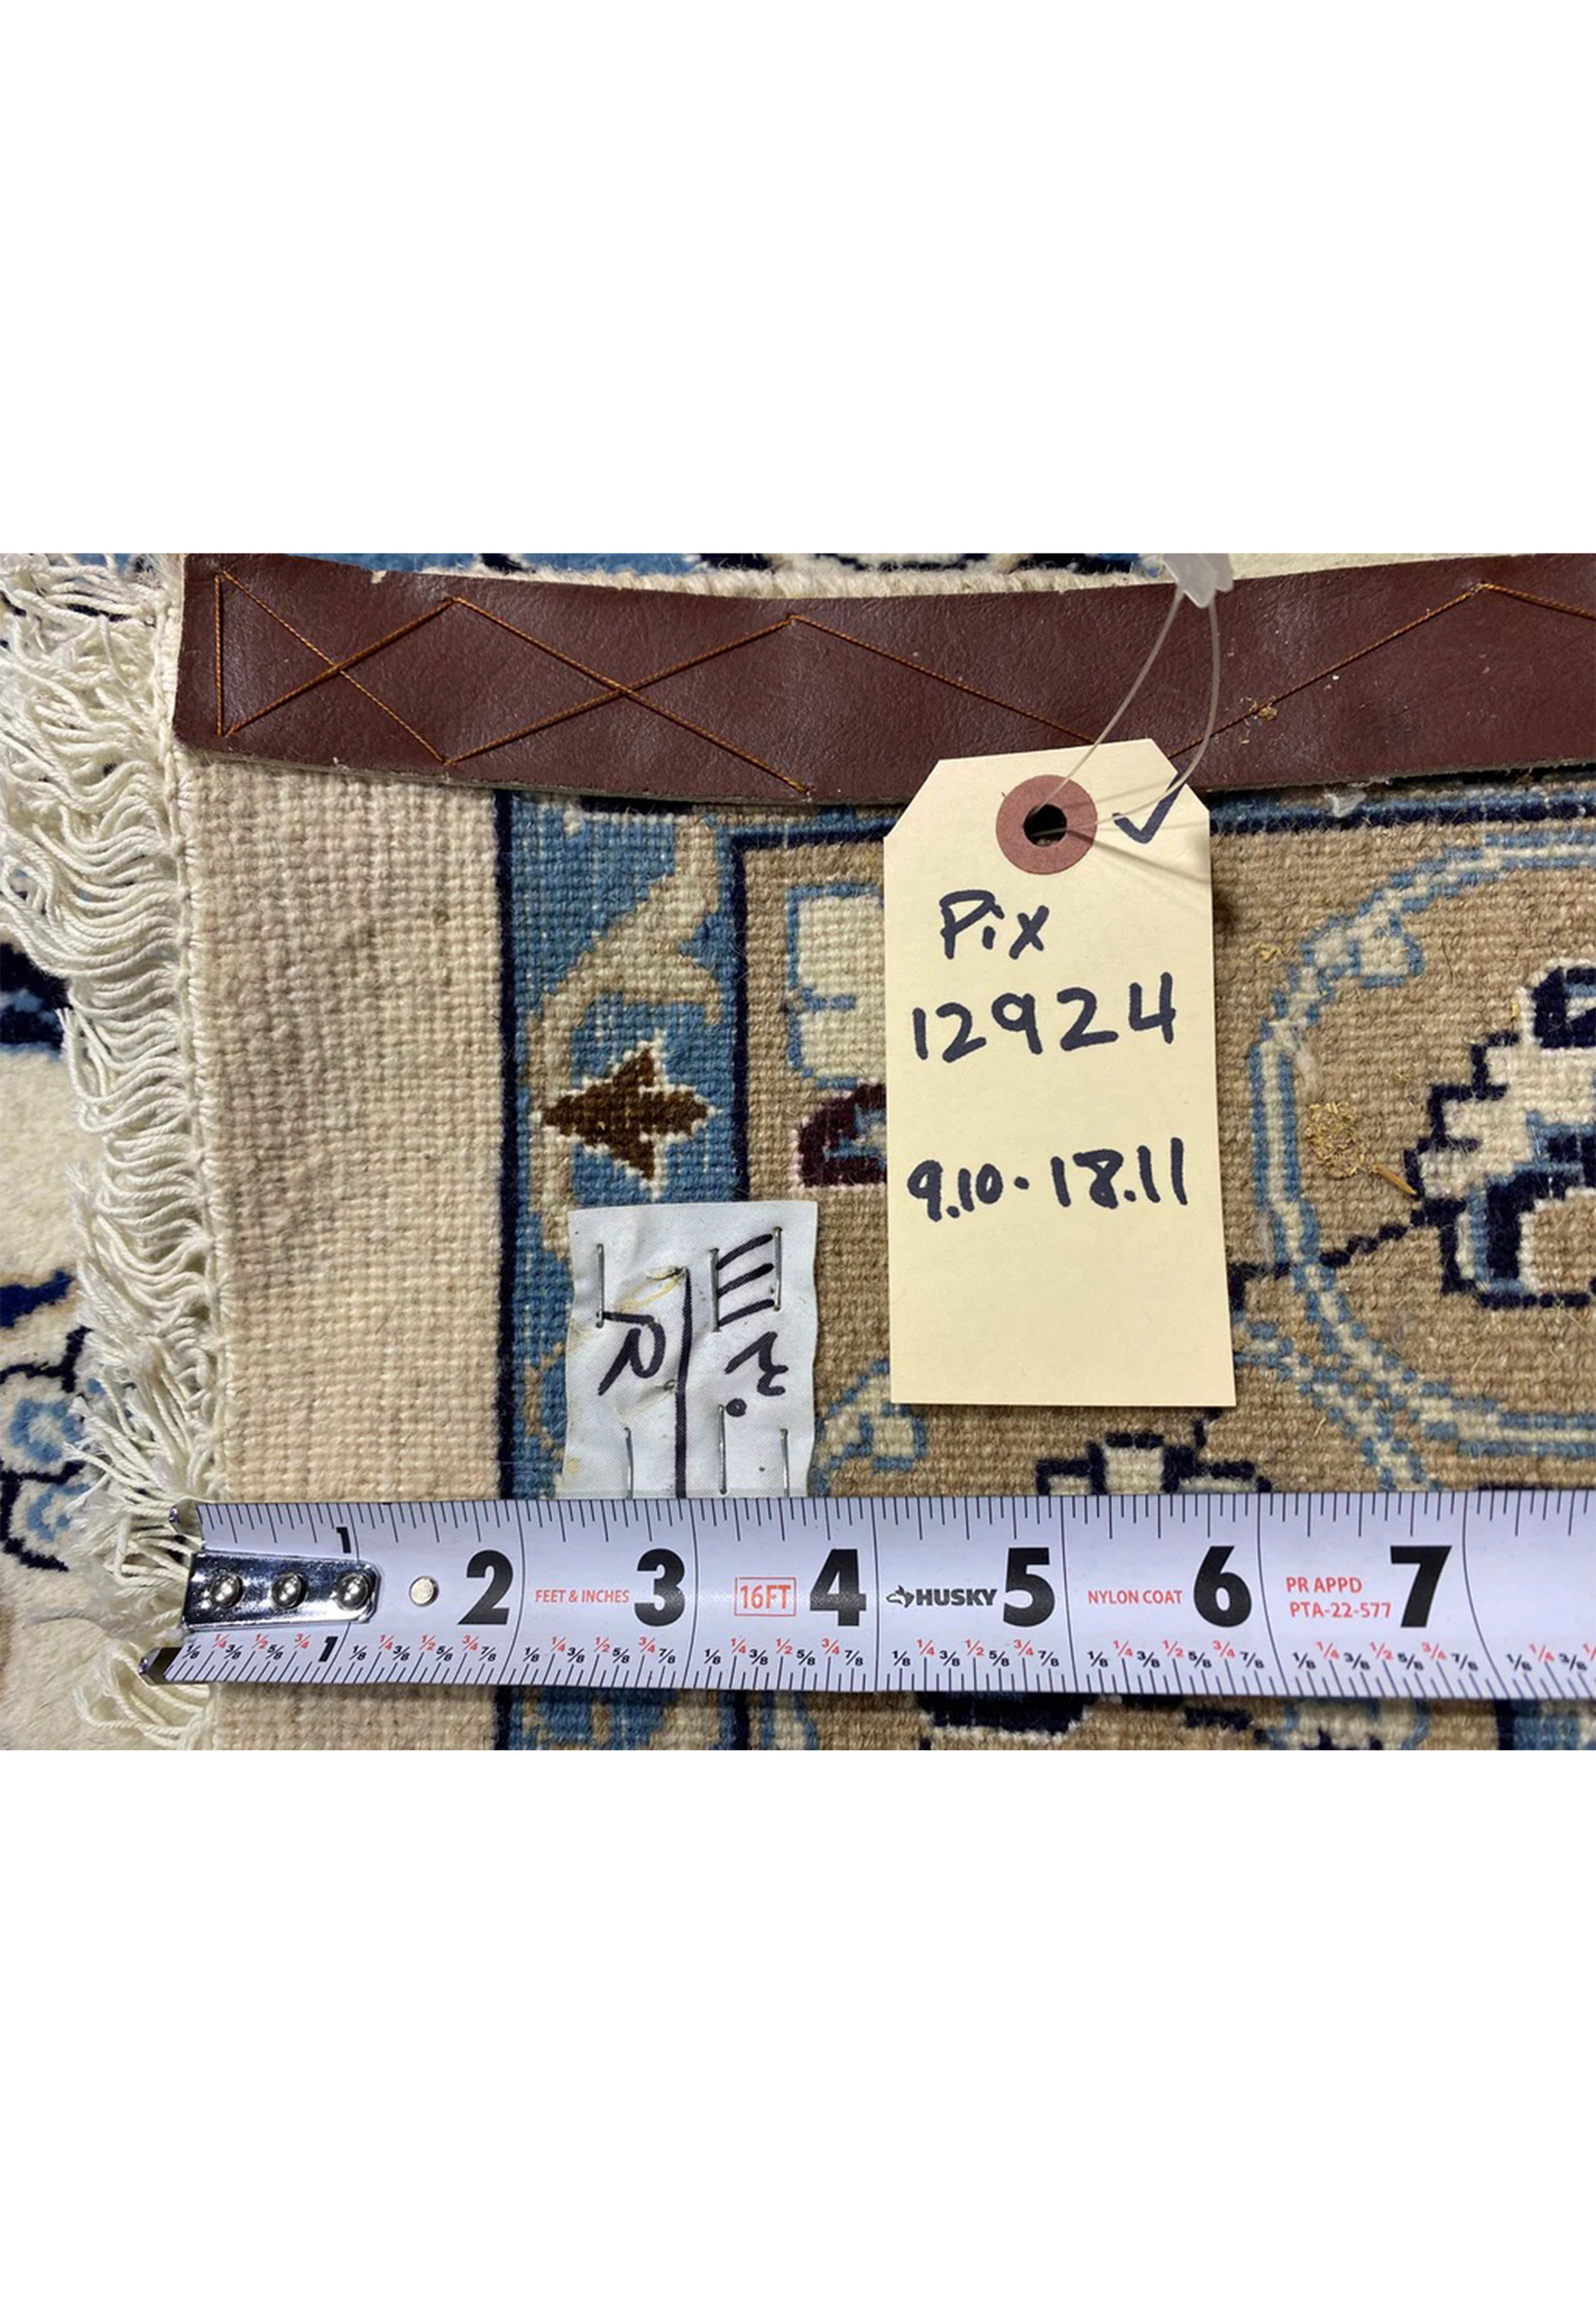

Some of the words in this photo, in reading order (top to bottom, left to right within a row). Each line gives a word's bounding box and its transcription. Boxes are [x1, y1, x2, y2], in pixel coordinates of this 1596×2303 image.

[939, 889, 1049, 960] Pix
[912, 971, 1176, 1063] 12924
[337, 1526, 352, 1554] 1
[457, 1549, 513, 1625] 2
[535, 1589, 566, 1603] FEET
[568, 1589, 579, 1603] &
[581, 1589, 630, 1604] INCHES
[634, 1548, 685, 1627] 3
[739, 1584, 791, 1609] 16FT
[809, 1549, 867, 1627] 4
[916, 1588, 998, 1607] HUSKY
[1003, 1547, 1056, 1627] 5
[1088, 1590, 1139, 1605] NYLON
[1143, 1590, 1182, 1605] COAT
[1193, 1545, 1252, 1628] 6
[1286, 1576, 1309, 1592] PR
[1313, 1576, 1362, 1594] APPD
[1390, 1545, 1453, 1628] 7
[1290, 1602, 1392, 1619] PTA-22-577
[318, 1636, 338, 1662] 1
